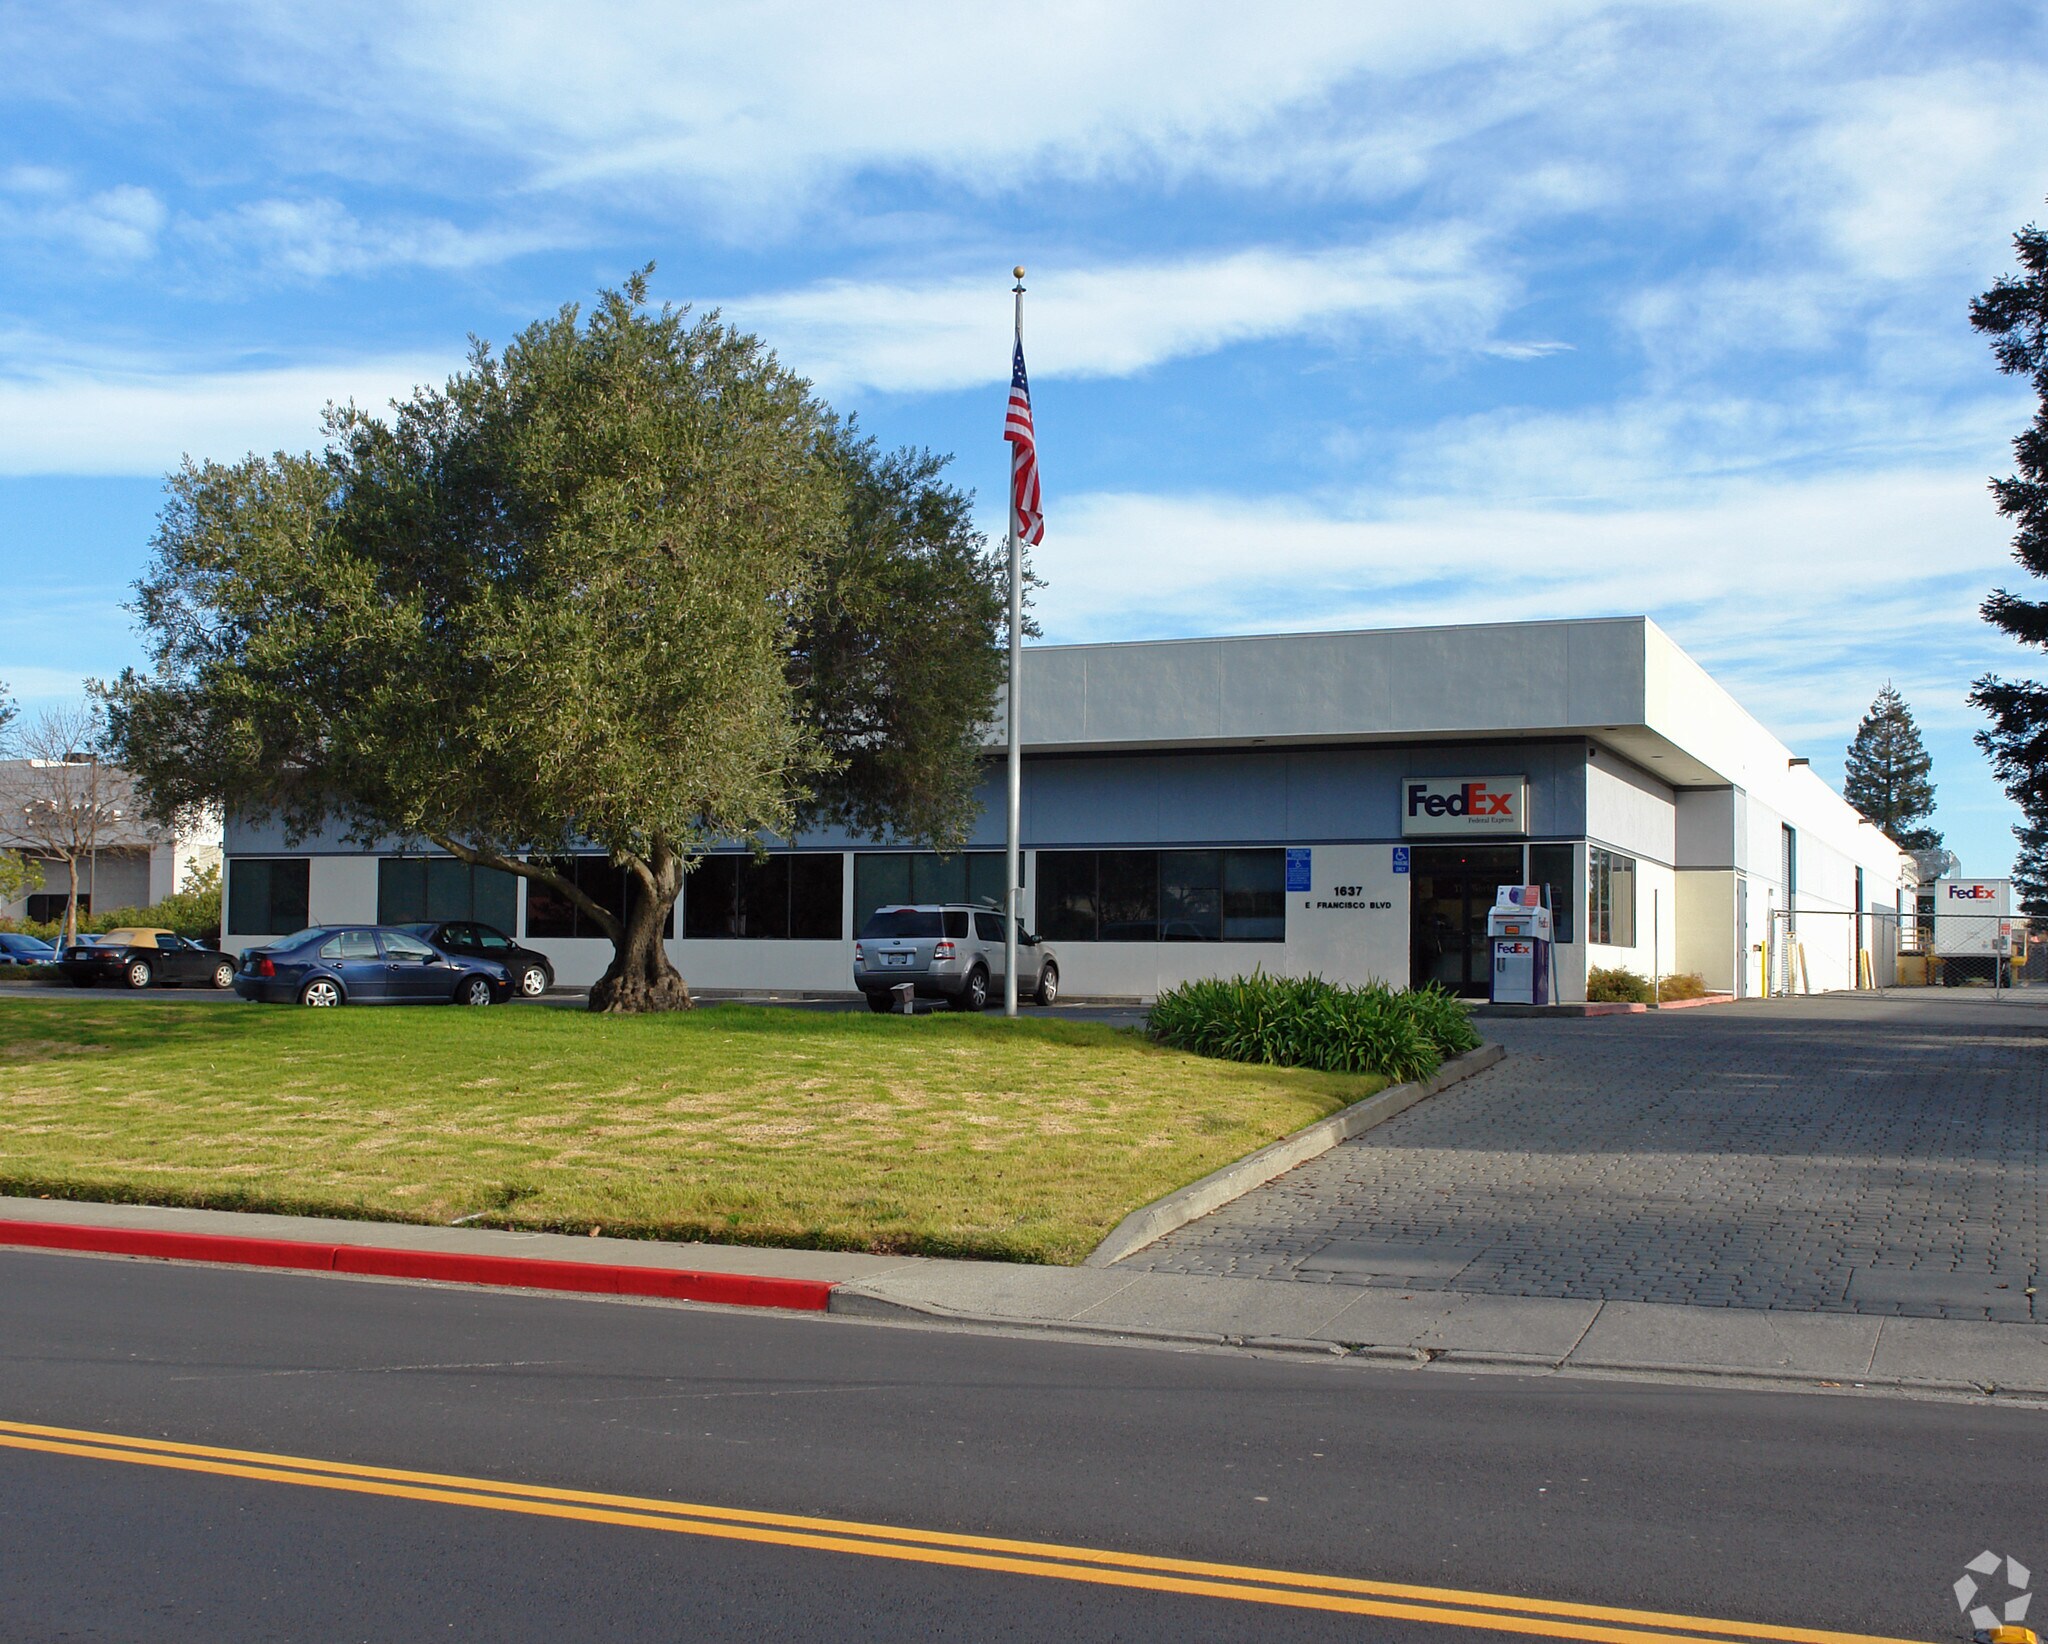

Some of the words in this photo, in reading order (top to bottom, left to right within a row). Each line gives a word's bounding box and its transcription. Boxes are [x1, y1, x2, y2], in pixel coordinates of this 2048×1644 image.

[1408, 783, 1513, 818] FedEx
[1491, 816, 1514, 825] Express
[1334, 886, 1363, 897] 1637
[1949, 885, 1996, 899] FedEx
[1497, 942, 1529, 954] FedEx
